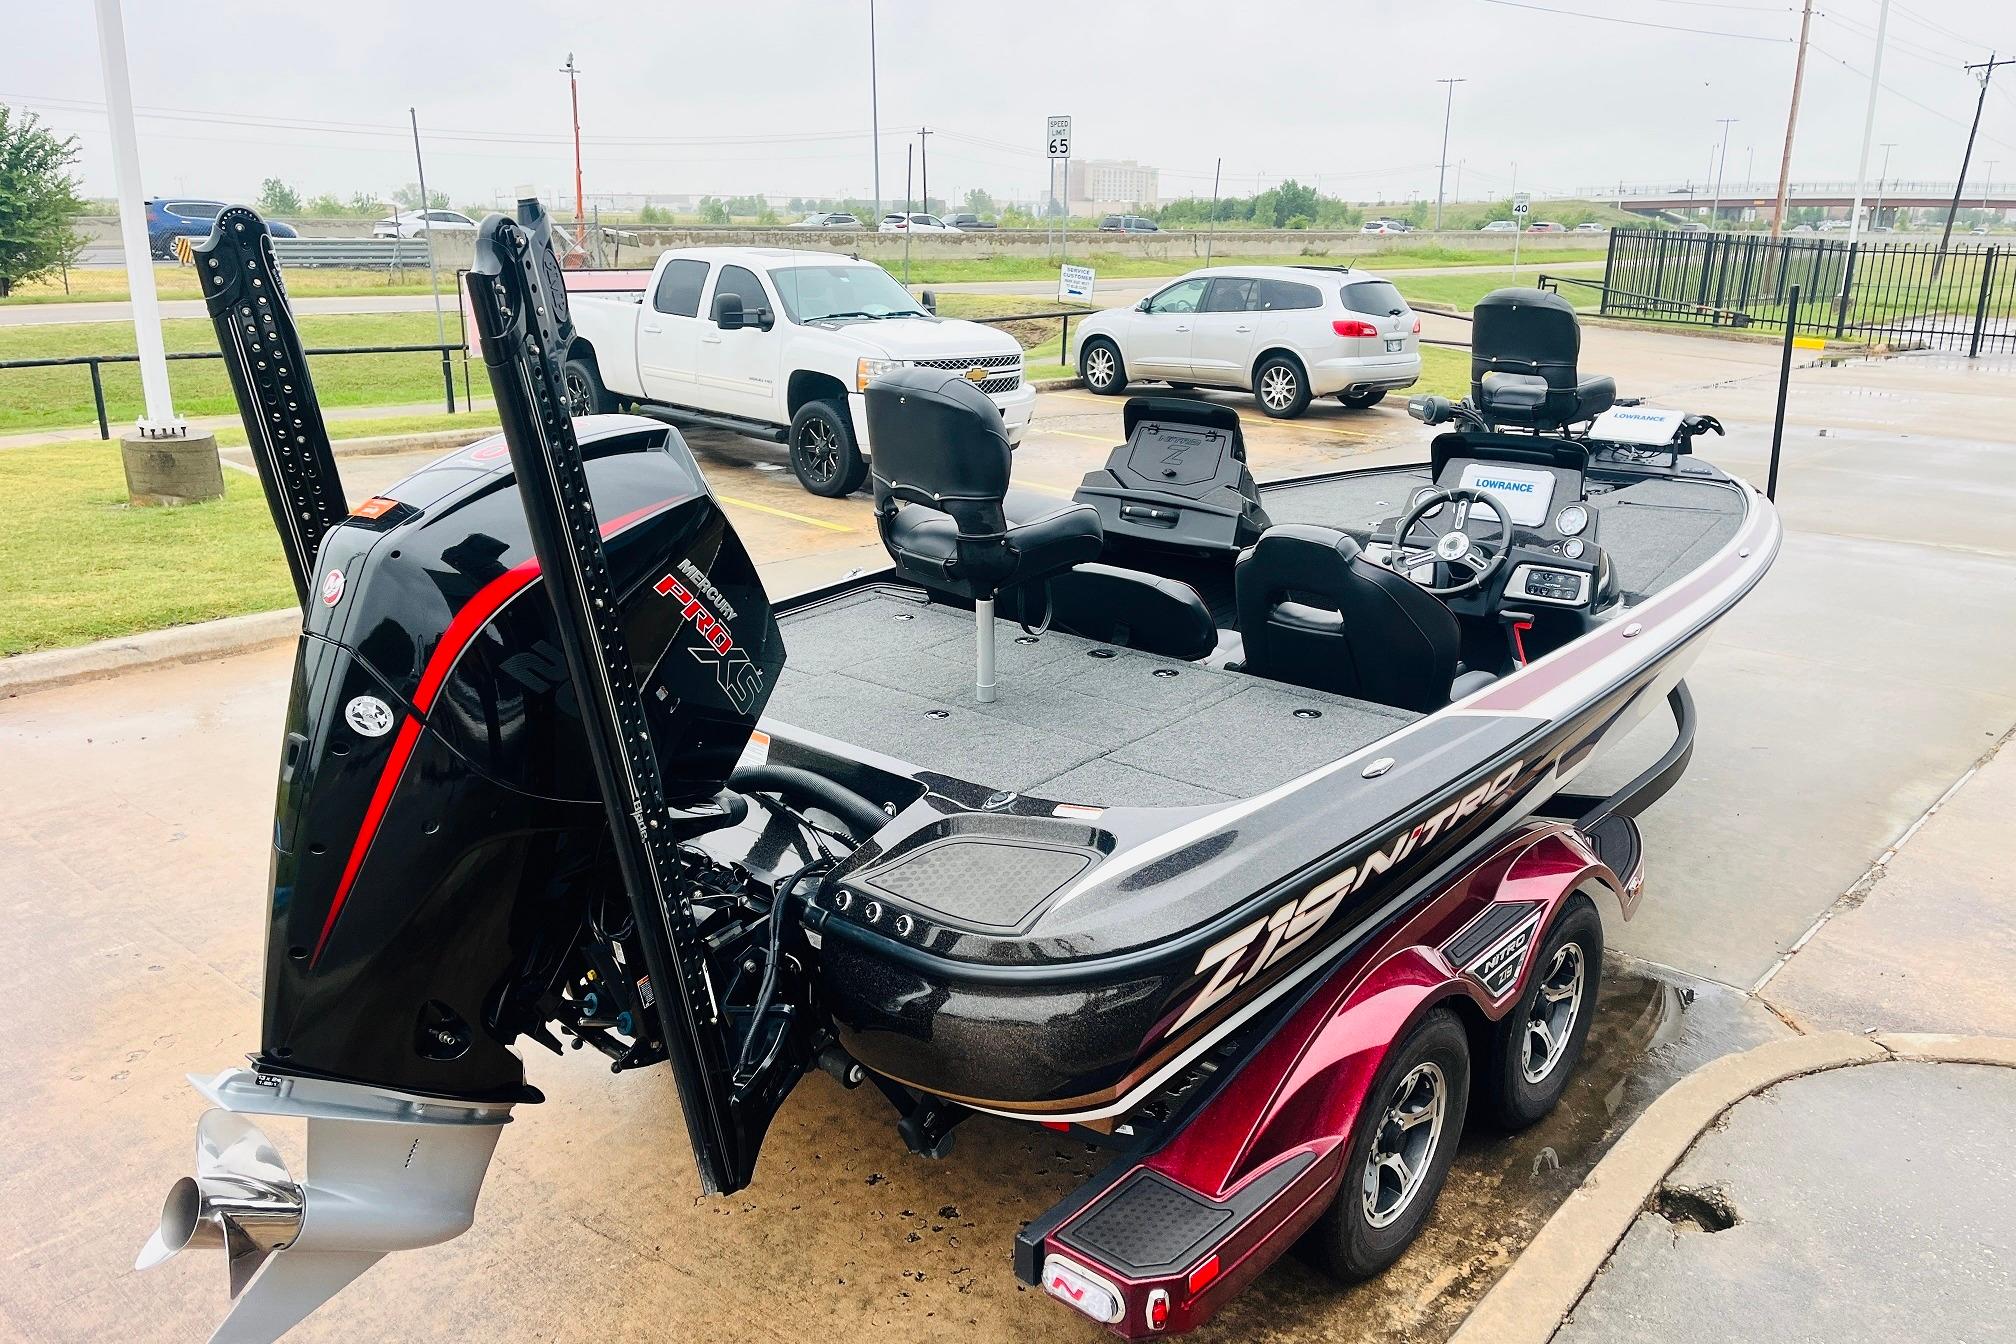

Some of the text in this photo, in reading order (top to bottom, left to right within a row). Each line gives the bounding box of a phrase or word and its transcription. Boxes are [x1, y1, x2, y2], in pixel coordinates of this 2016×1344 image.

[1050, 120, 1068, 128] SPEED
[1049, 138, 1068, 154] 65
[1514, 204, 1528, 213] 40
[1063, 272, 1092, 281] CUSTOMER
[1613, 412, 1666, 422] LOWRANCE
[1160, 444, 1191, 466] Z
[1475, 478, 1535, 493] LOWRANCE
[677, 558, 738, 622] MERCURY
[652, 573, 734, 657] PRO
[687, 647, 764, 716] XS
[1349, 759, 1525, 894] NITRO
[1484, 933, 1526, 974] NITRO
[1498, 964, 1513, 986] Z19
